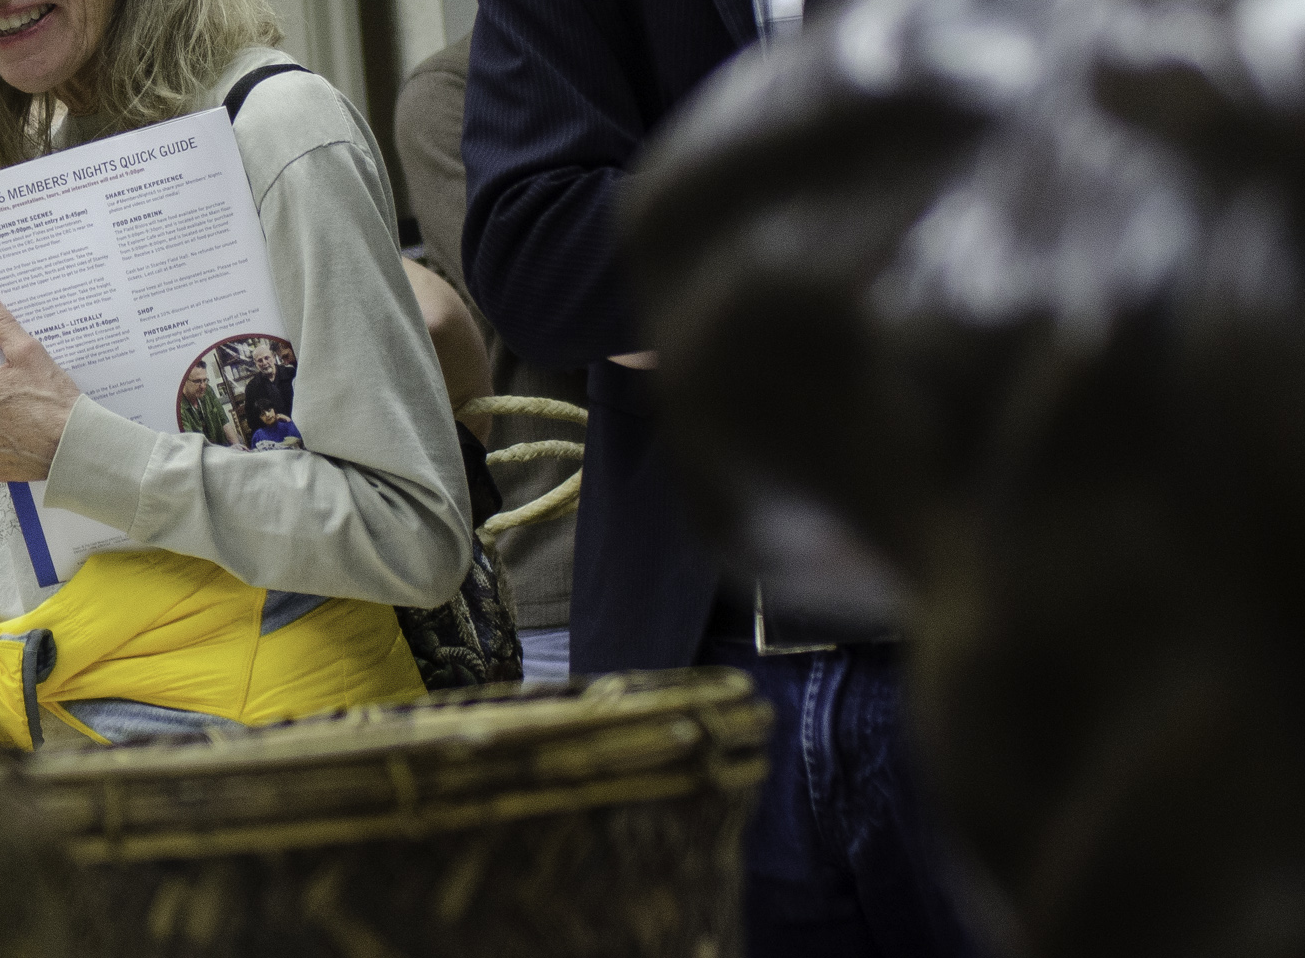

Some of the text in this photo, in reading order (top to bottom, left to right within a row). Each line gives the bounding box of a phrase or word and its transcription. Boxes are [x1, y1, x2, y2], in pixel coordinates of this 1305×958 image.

[7, 173, 71, 200] MEMBERS'
[73, 160, 117, 182] NIGHTS
[119, 149, 156, 170] QUICK
[159, 137, 198, 158] GUIDE
[105, 174, 183, 200] SHARE YOUR EXPERIENCE
[17, 217, 28, 225] THE
[30, 210, 53, 221] SCENES
[44, 217, 58, 226] entry
[65, 209, 88, 221] 8:45pm)
[112, 219, 128, 228] FOOD
[143, 210, 163, 219] DRINK
[137, 306, 154, 315] SHOP
[34, 323, 65, 335] MAMMALS
[70, 313, 103, 326] LITERALLY
[144, 320, 189, 336] PHOTOGRAPHY
